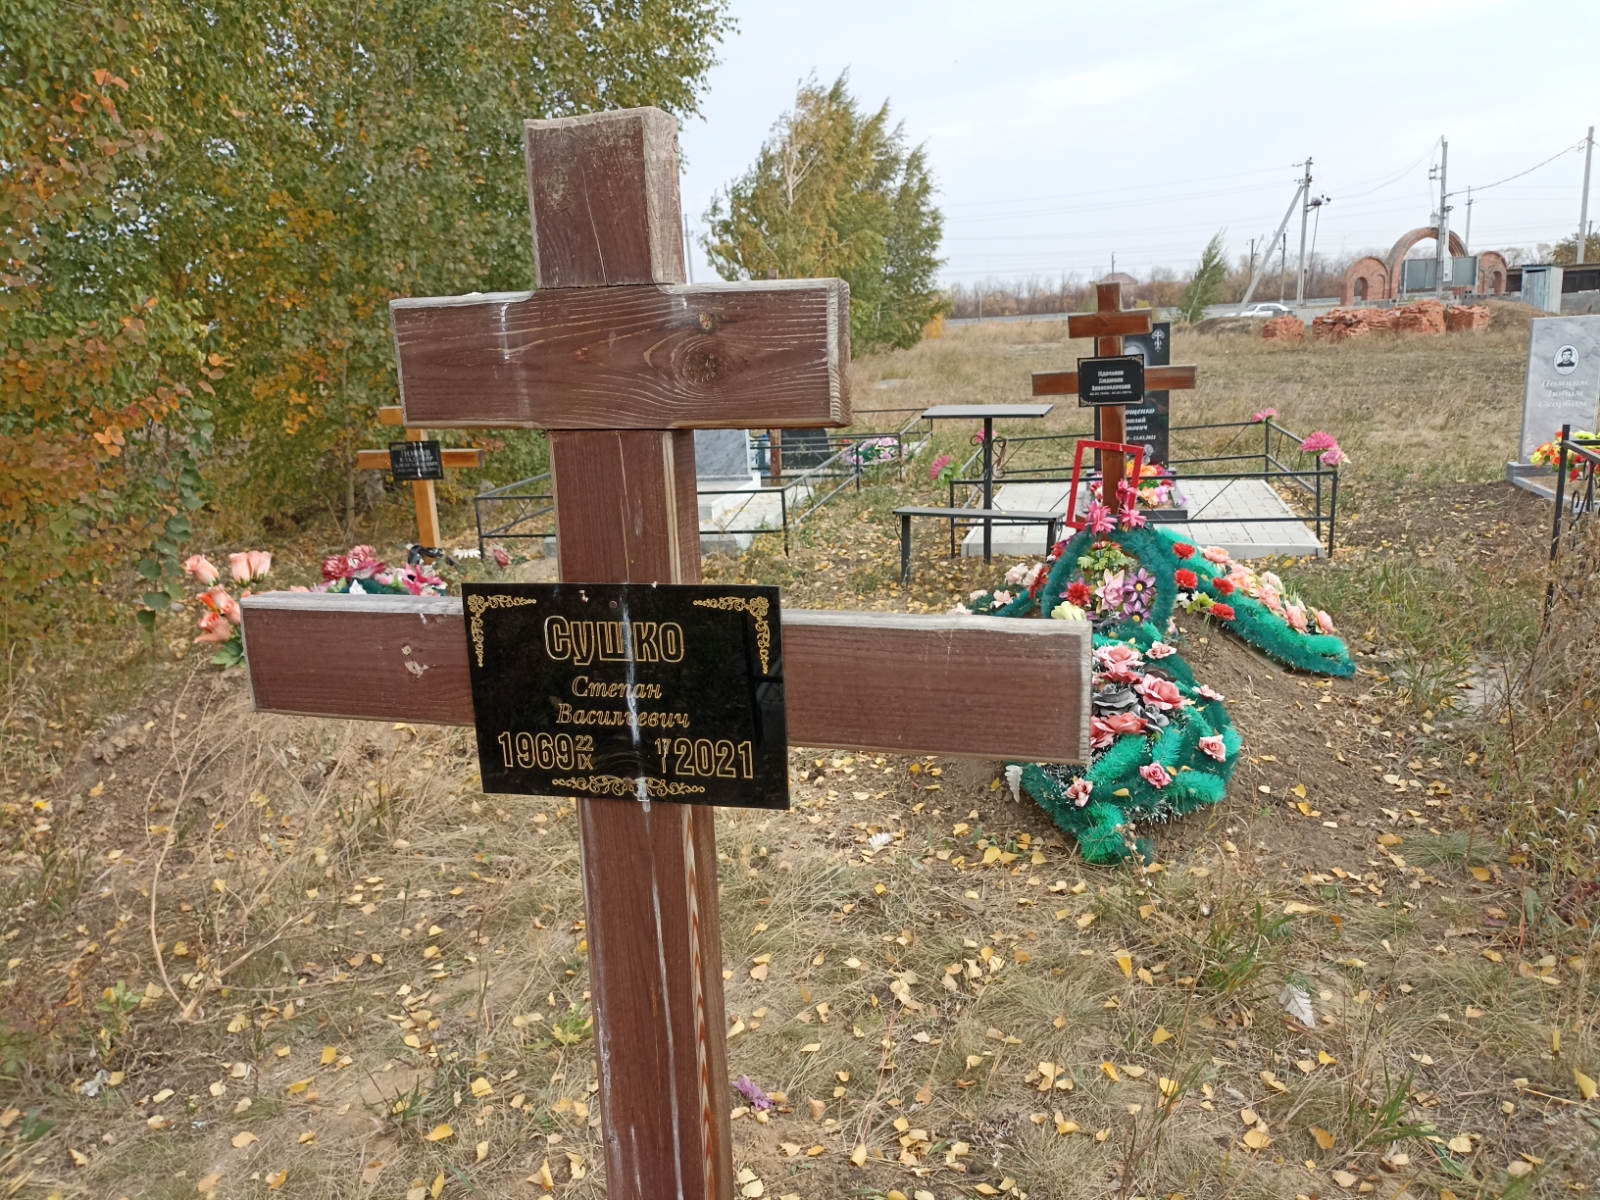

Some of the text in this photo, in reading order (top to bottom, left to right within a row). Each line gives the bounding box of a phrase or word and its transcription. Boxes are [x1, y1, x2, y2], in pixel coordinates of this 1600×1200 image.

[1541, 379, 1589, 388] Помним
[1543, 389, 1584, 398] Любим
[1537, 399, 1588, 409] Скорбим
[571, 675, 662, 699] Степан
[556, 703, 690, 728] Васильевич
[498, 731, 575, 770] 1969
[575, 735, 594, 751] 22
[654, 738, 672, 757] 17
[674, 737, 754, 780] 2021
